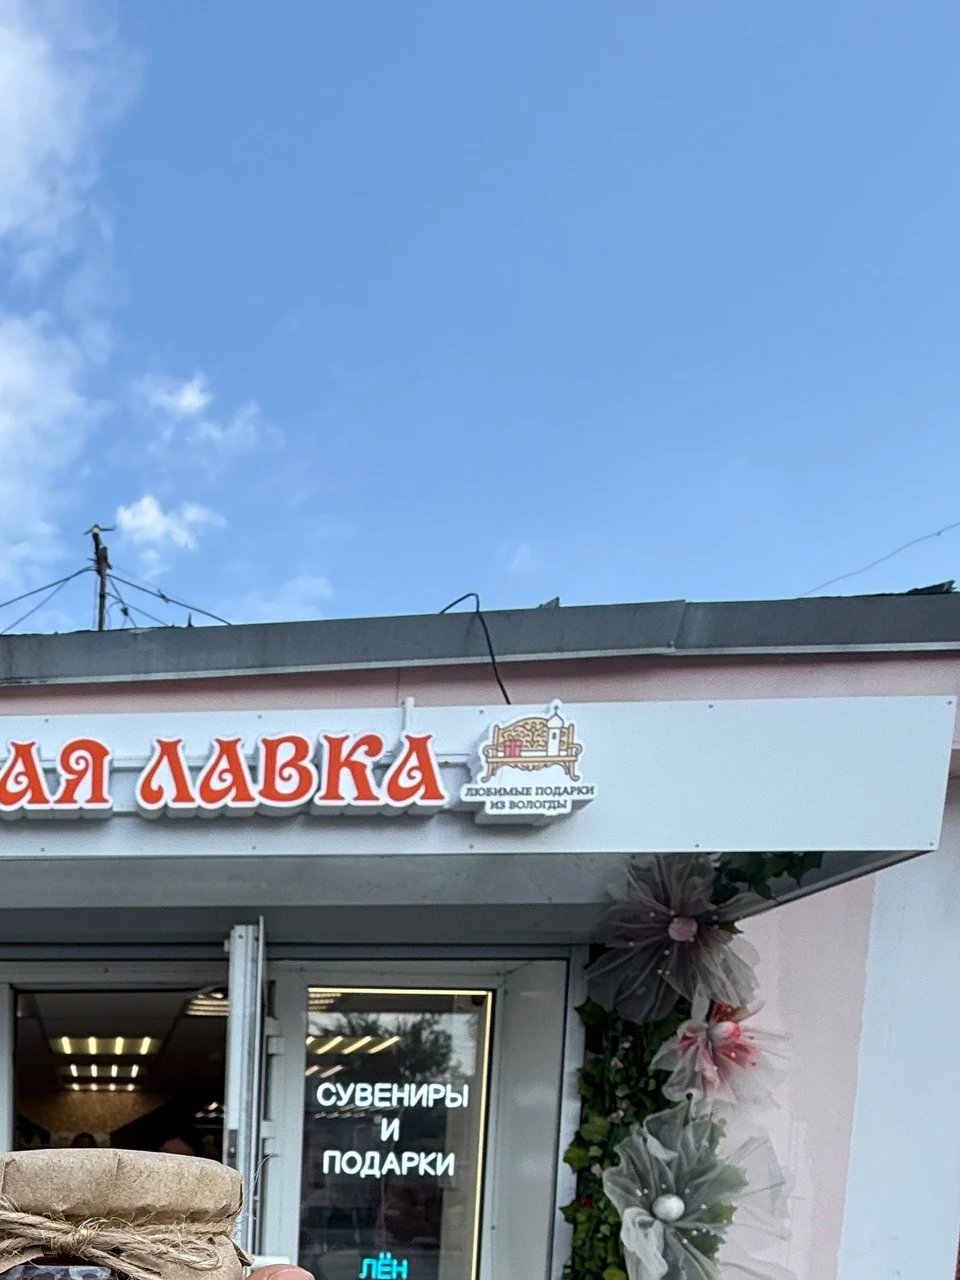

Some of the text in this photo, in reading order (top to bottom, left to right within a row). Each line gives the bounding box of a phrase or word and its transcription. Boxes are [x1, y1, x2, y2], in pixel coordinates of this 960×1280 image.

[139, 733, 446, 806] ЛАВКА
[464, 785, 596, 798] ЛЮБИМЫЕ ПОДАРКИ
[489, 799, 568, 811] ИЗ ВОЛОГДЫ
[315, 1081, 470, 1109] СУВЕНИРЫ
[379, 1117, 401, 1142] И
[321, 1150, 456, 1179] ПОДАРКИ
[358, 1252, 408, 1280] ЛЁН
